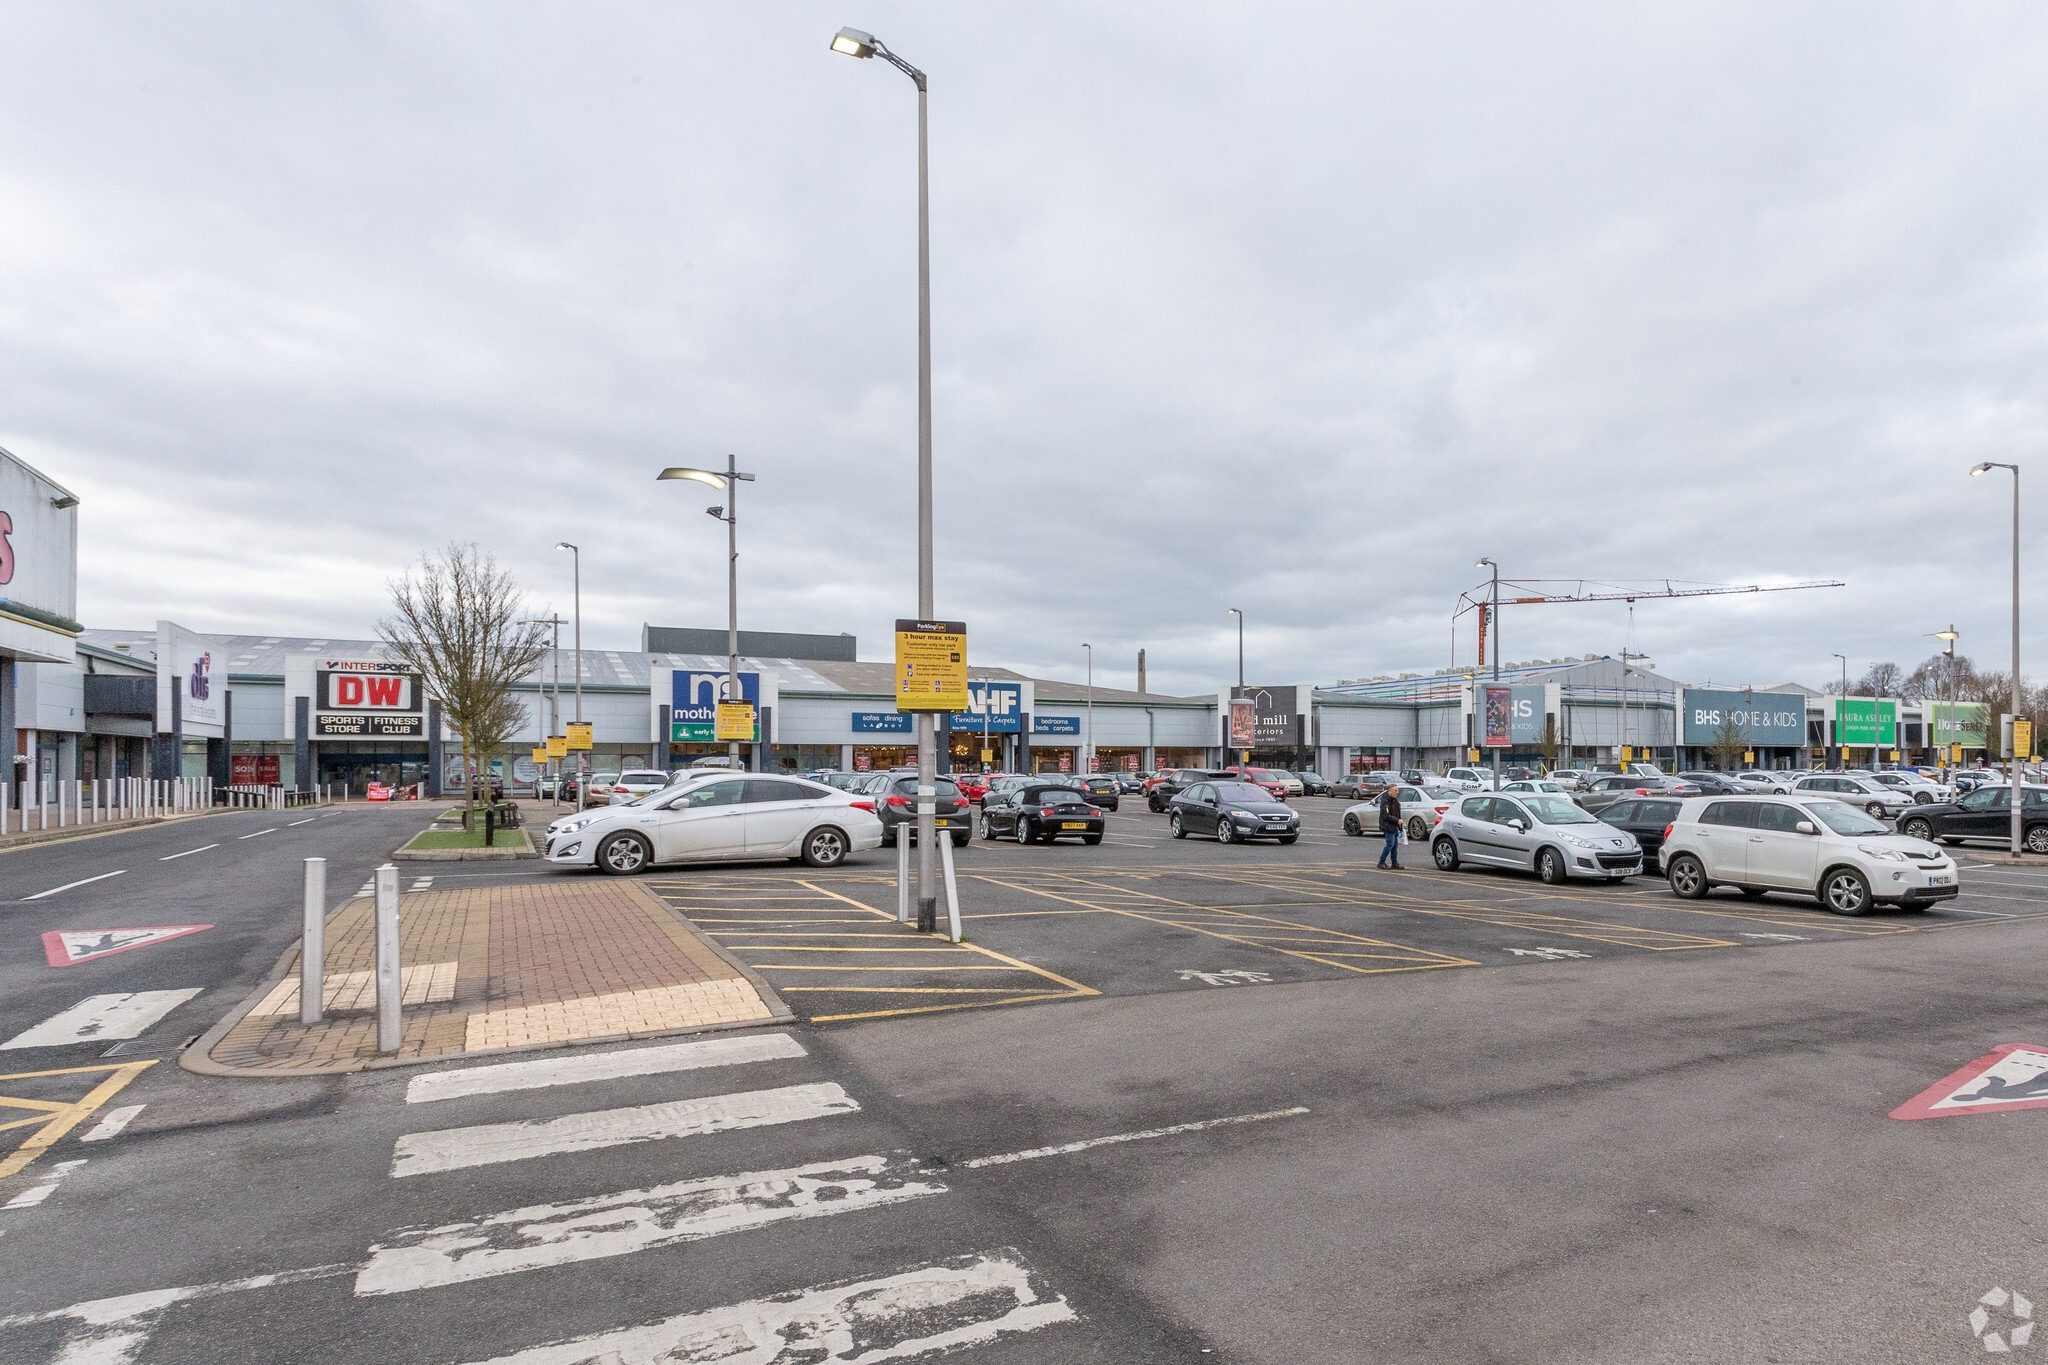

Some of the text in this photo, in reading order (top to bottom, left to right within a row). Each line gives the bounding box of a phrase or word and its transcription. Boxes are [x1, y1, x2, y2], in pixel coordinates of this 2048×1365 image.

[341, 662, 410, 672] INTERSPORT
[339, 676, 402, 706] DW
[1511, 700, 1532, 718] HS
[374, 717, 418, 725] FITNESS
[884, 715, 902, 723] dining
[952, 714, 983, 723] Furniture
[992, 716, 1016, 726] Carpets
[1263, 715, 1288, 725] mill
[1695, 710, 1796, 727] BHS HOME & KIDS
[1840, 712, 1864, 722] LAURA
[382, 726, 410, 734] CLUB
